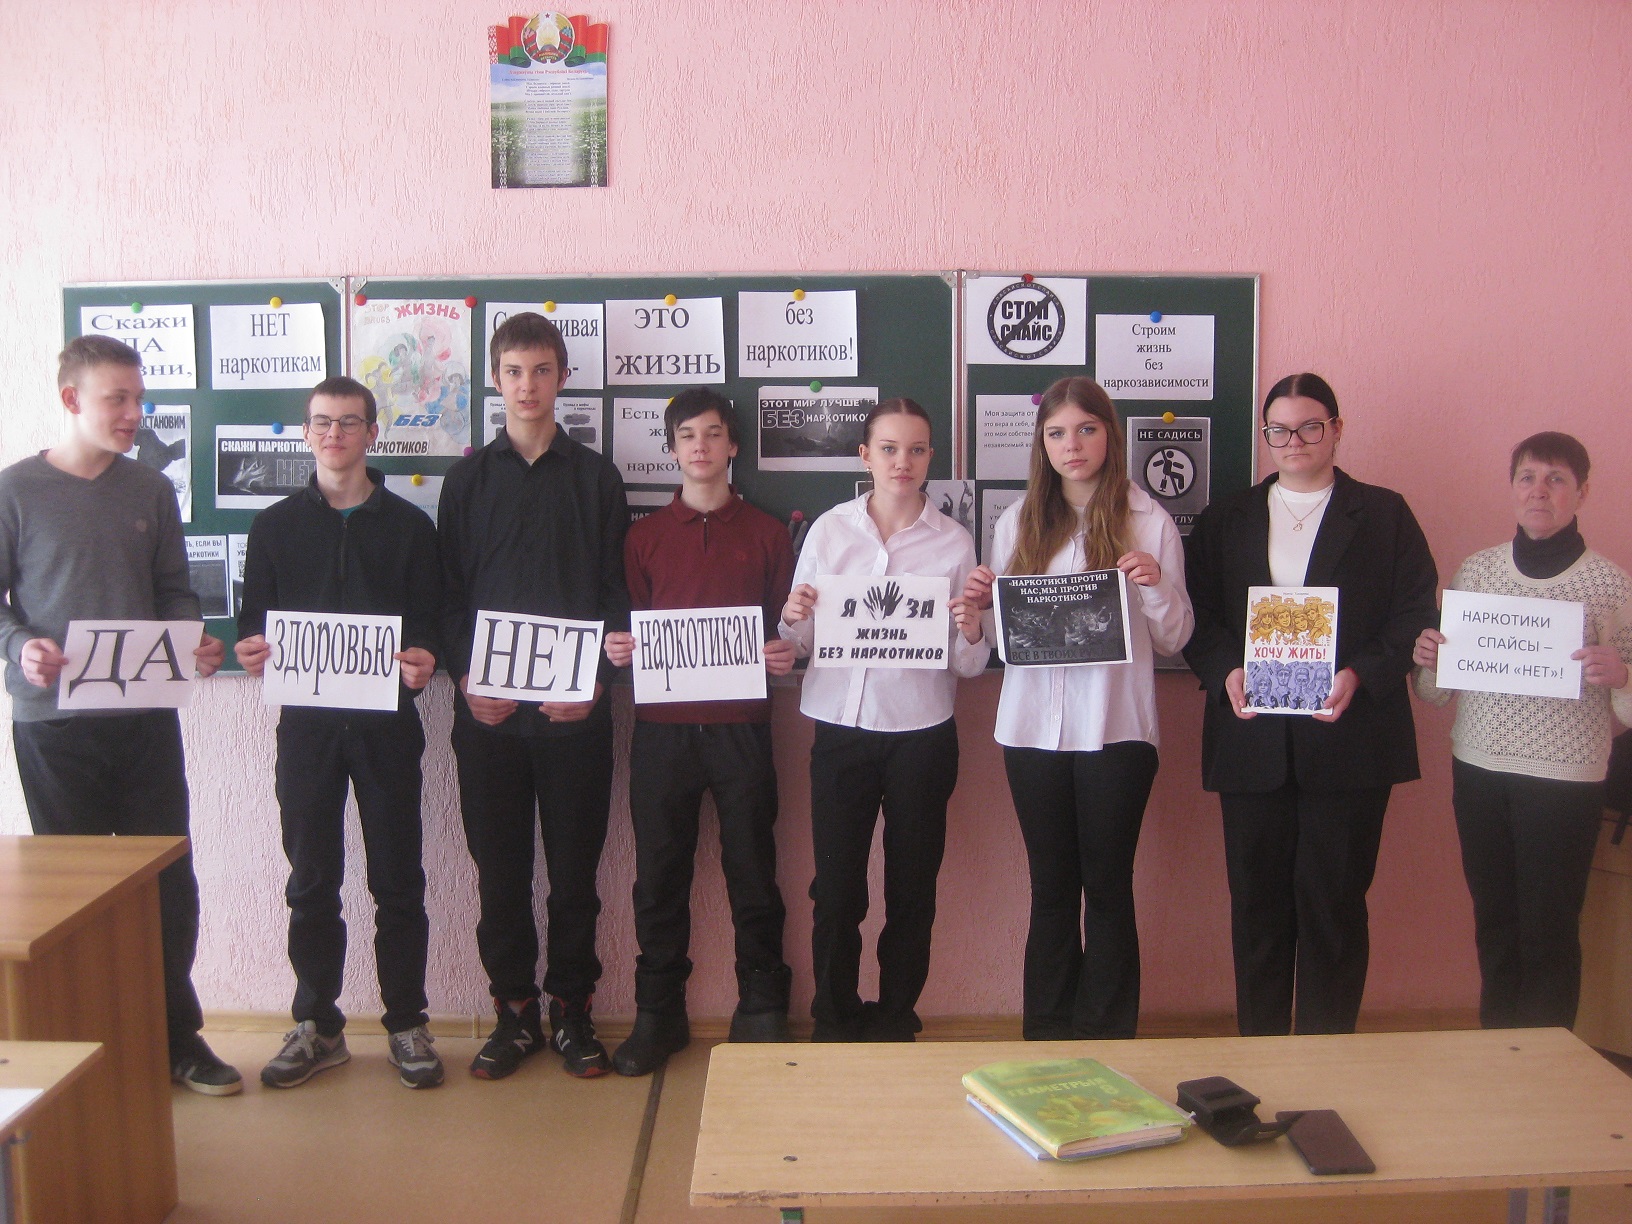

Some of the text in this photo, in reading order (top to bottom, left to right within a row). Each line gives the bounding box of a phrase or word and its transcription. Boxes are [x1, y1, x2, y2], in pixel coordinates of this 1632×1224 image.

[394, 303, 460, 320] ЖИЗНЬ
[785, 301, 814, 325] без
[91, 314, 187, 331] Скажи
[250, 312, 290, 337] НЕТ
[1132, 323, 1176, 338] Строим
[746, 337, 853, 367] наркотиков!
[1136, 343, 1172, 354] жизнь
[219, 356, 321, 380] наркотикам
[1144, 357, 1163, 371] без
[1104, 377, 1209, 390] наркозависимости
[762, 400, 789, 408] ЭТОТ
[794, 400, 816, 408] МИР
[394, 414, 439, 427] БЕЗ
[622, 408, 659, 420] Есть
[762, 409, 806, 428] БЕЗ
[1139, 430, 1201, 440] НЕ САДИСЬ
[221, 441, 256, 452] СКАЖИ
[1070, 573, 1108, 583] ПРОТИВ
[1060, 583, 1098, 593] ПРОТИВ
[840, 598, 935, 619] Я ЗА
[1462, 610, 1550, 629] НАРКОТИКИ
[855, 627, 907, 640] ЖИЗНЬ
[1477, 636, 1539, 652] СПАЙСЫ
[476, 617, 598, 692] НЕТ
[638, 614, 759, 692] наркотикам
[819, 646, 944, 660] БЕЗ НАРКОТИКОВ
[1254, 647, 1326, 659] ХОЧУ ЖИТЬ!
[69, 628, 188, 699] ДА
[1457, 659, 1564, 680] СКАЖИ «НЕТ»!
